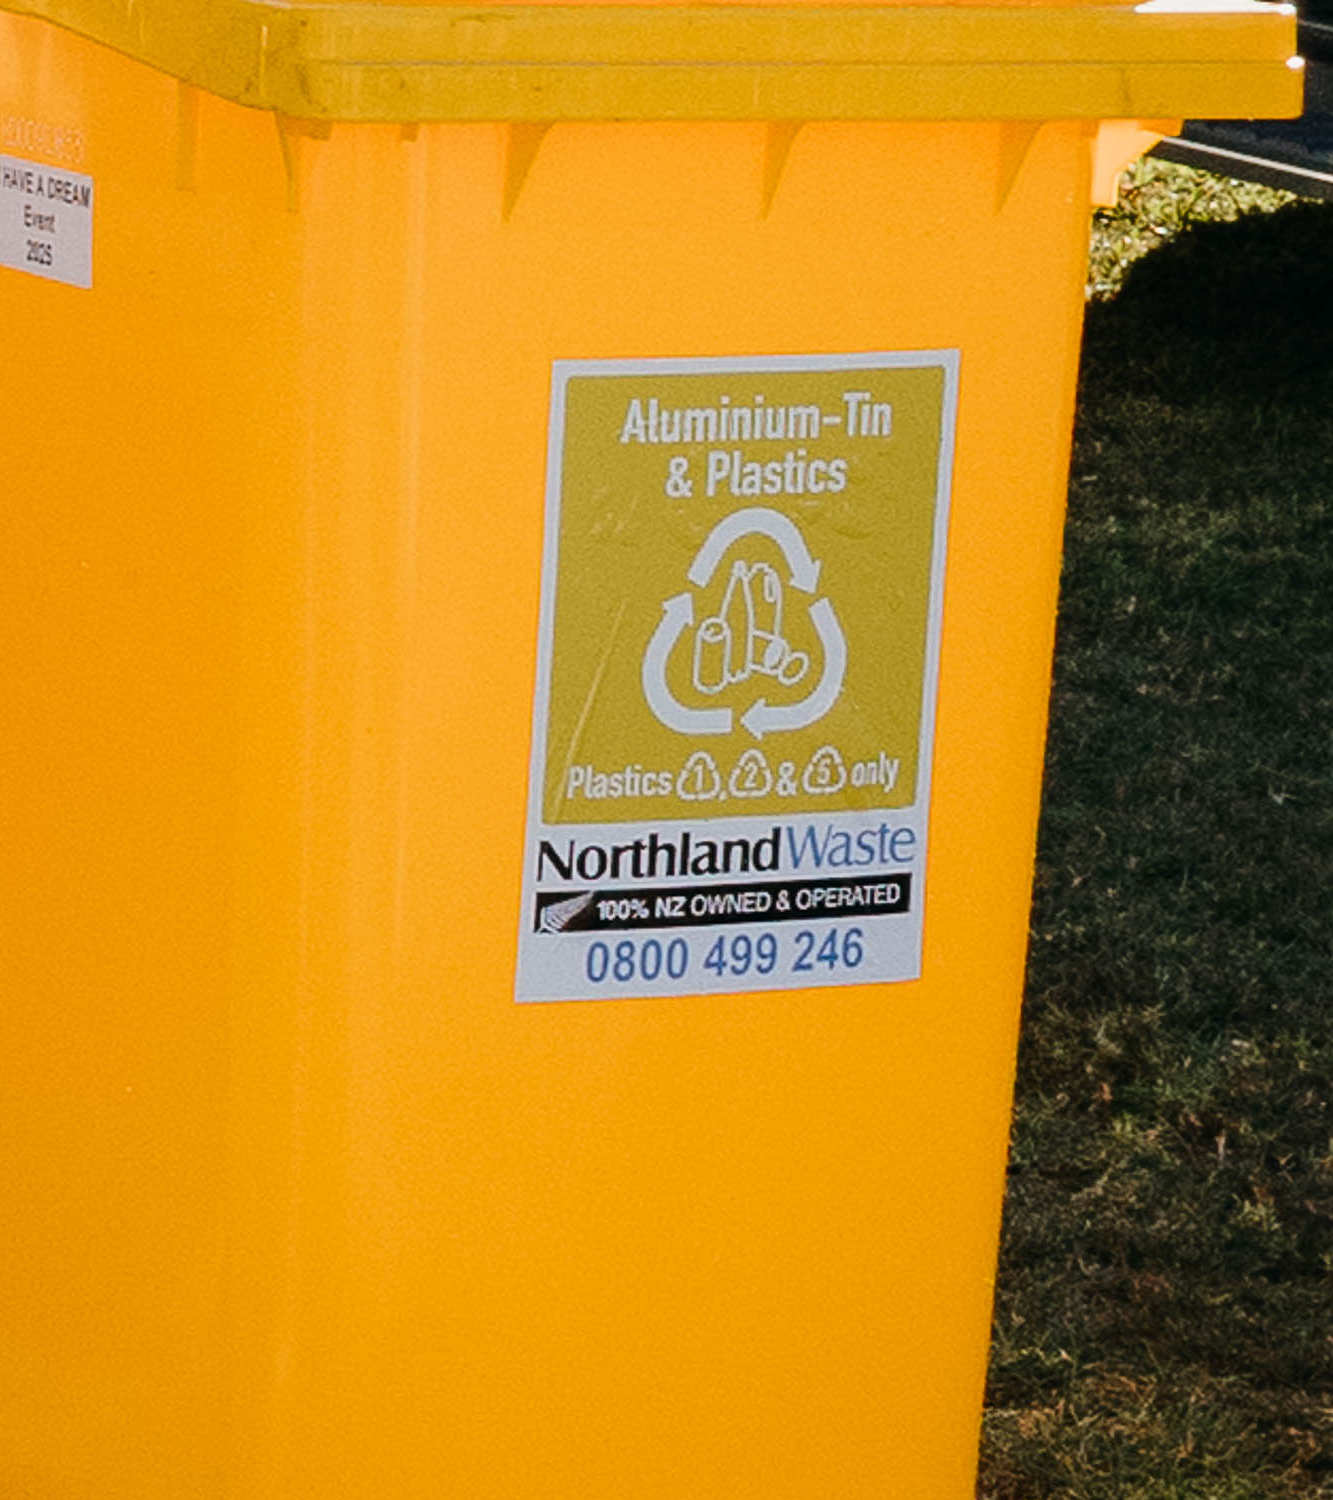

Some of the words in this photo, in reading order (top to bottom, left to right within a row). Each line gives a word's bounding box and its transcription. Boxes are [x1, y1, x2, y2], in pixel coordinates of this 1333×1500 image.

[2, 165, 35, 195] HAVE
[36, 174, 45, 198] A
[47, 176, 92, 209] DREAM
[23, 203, 57, 234] Event
[619, 391, 893, 445] Aluminium-Tin
[665, 460, 693, 499] &
[706, 450, 848, 499] Plastics
[567, 764, 672, 801] Plastics
[777, 766, 797, 797] &
[851, 752, 900, 792] only
[596, 898, 649, 921] 100%
[654, 895, 685, 918] NZ
[690, 890, 772, 916] OWNED
[776, 889, 790, 912] &
[795, 883, 901, 911] OPERATED
[587, 938, 689, 983] 0800
[704, 933, 779, 977] 499
[791, 928, 865, 973] 246
